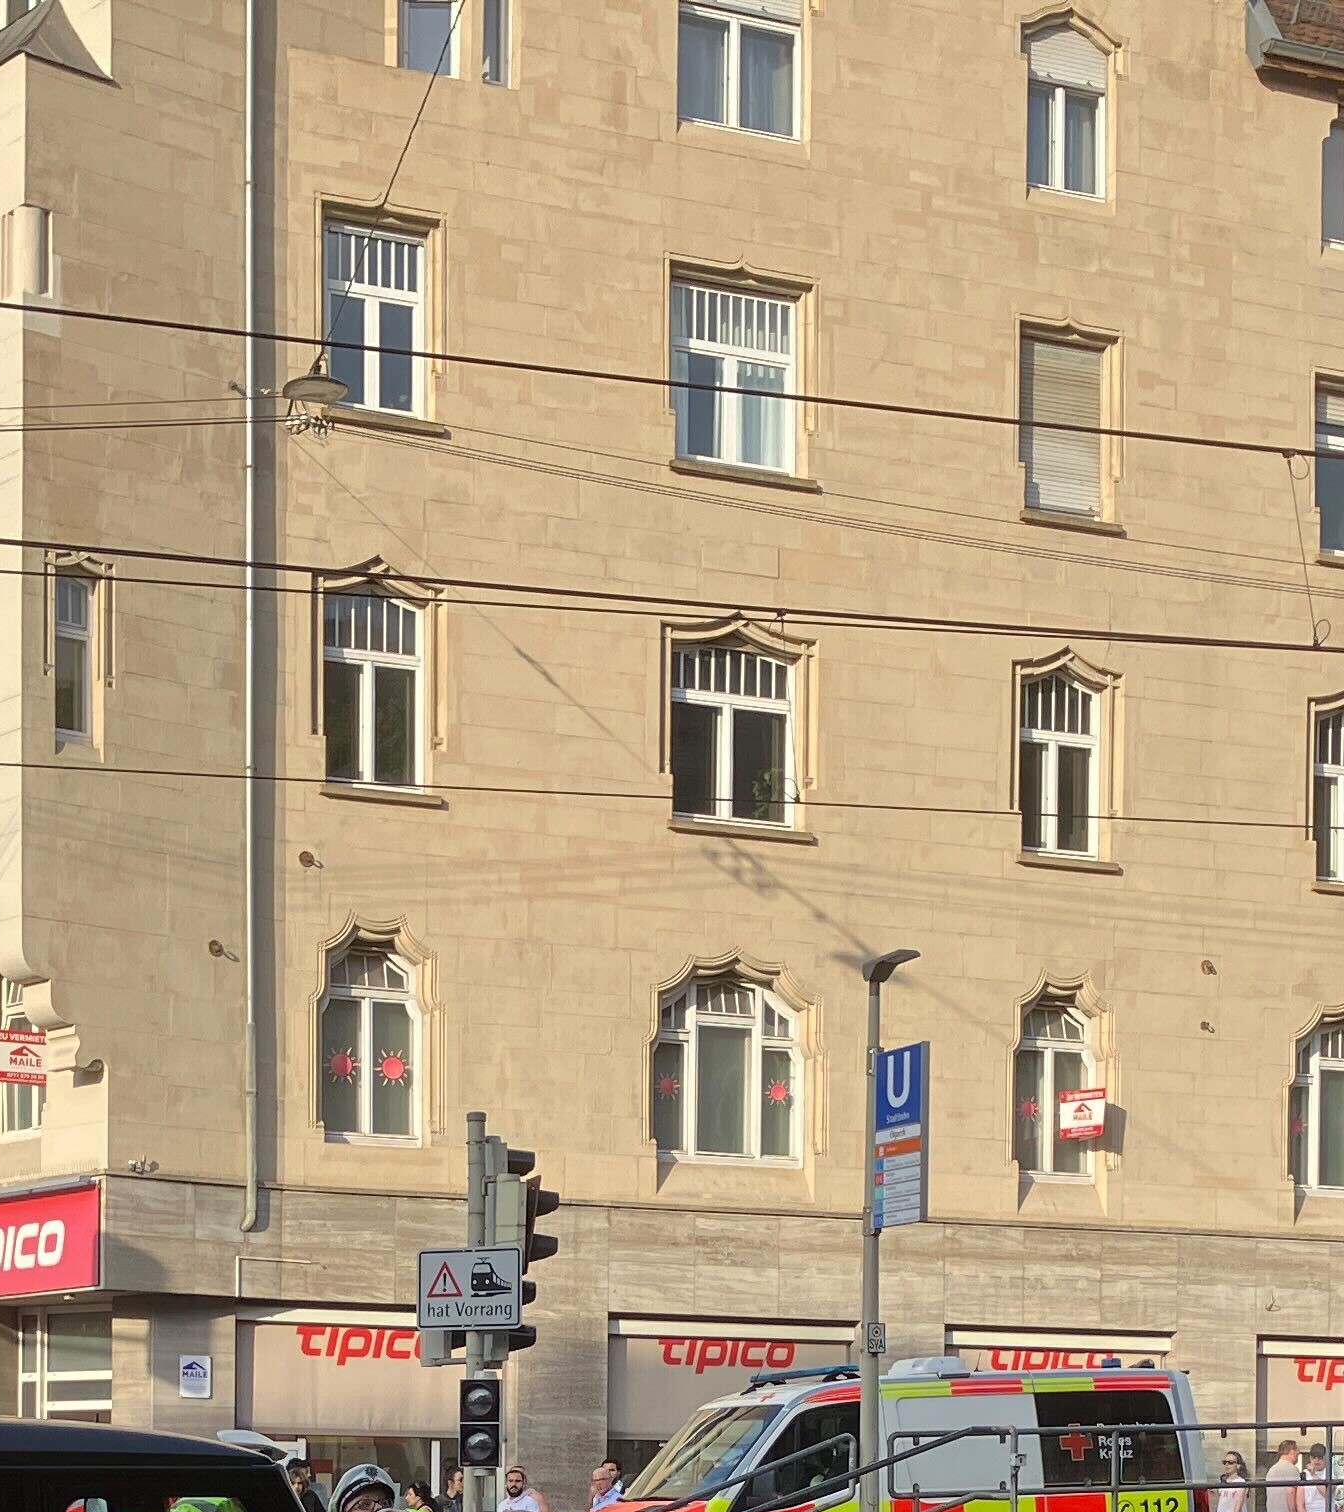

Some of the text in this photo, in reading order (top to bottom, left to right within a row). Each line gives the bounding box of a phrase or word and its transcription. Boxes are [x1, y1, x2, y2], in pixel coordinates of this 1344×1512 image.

[9, 1057, 43, 1067] MAILE
[887, 1051, 911, 1108] U
[427, 1302, 513, 1320] hat Vorrang
[295, 1325, 422, 1366] tipic
[658, 1338, 797, 1375] tipico
[182, 1371, 208, 1379] MAILE
[1098, 1435, 1132, 1447] Roes
[1099, 1448, 1134, 1460] Kruz
